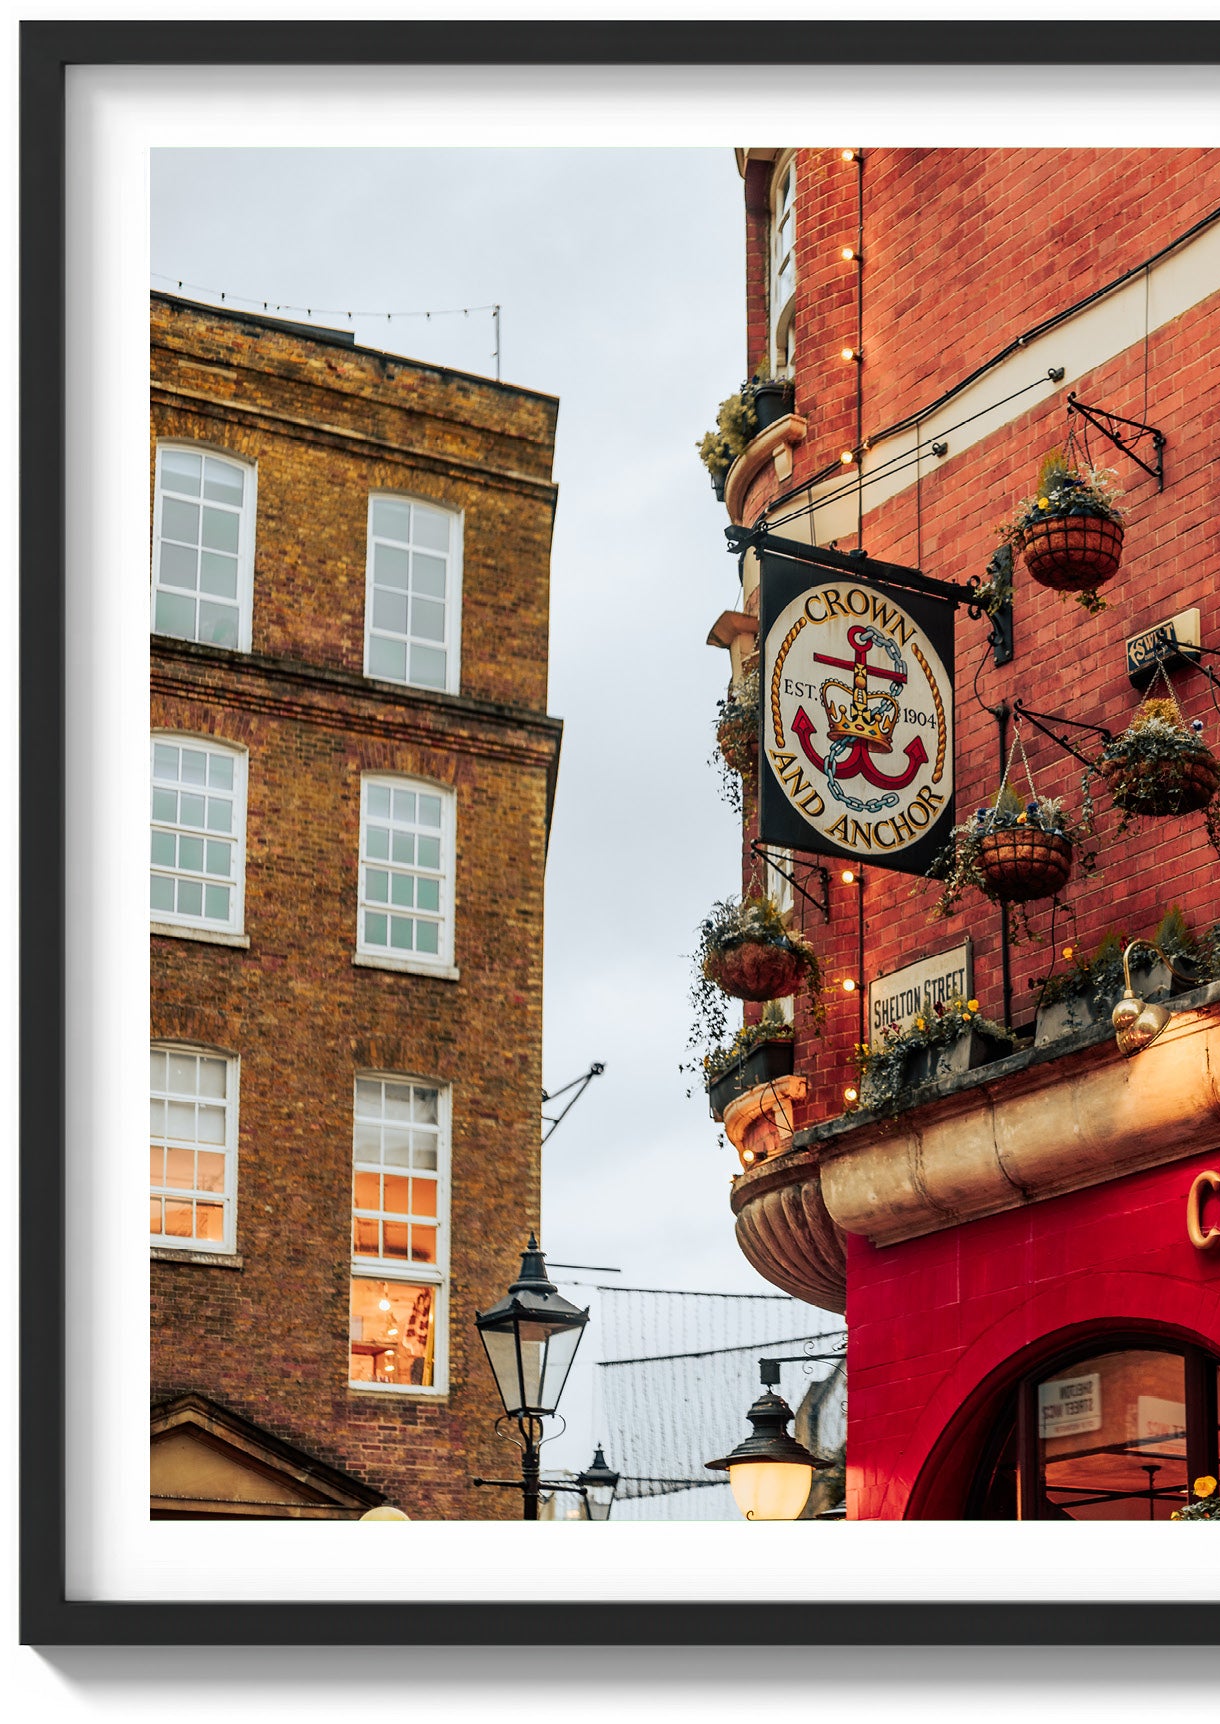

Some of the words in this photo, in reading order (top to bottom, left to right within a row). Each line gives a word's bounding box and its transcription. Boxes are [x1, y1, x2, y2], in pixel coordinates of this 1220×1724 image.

[804, 588, 918, 646] CROWN
[784, 678, 818, 702] EST.
[903, 707, 937, 730] 1904
[769, 748, 826, 818] AND
[825, 784, 945, 851] ANCHOR
[874, 985, 921, 1029] SHELTON
[923, 968, 965, 1004] STREET
